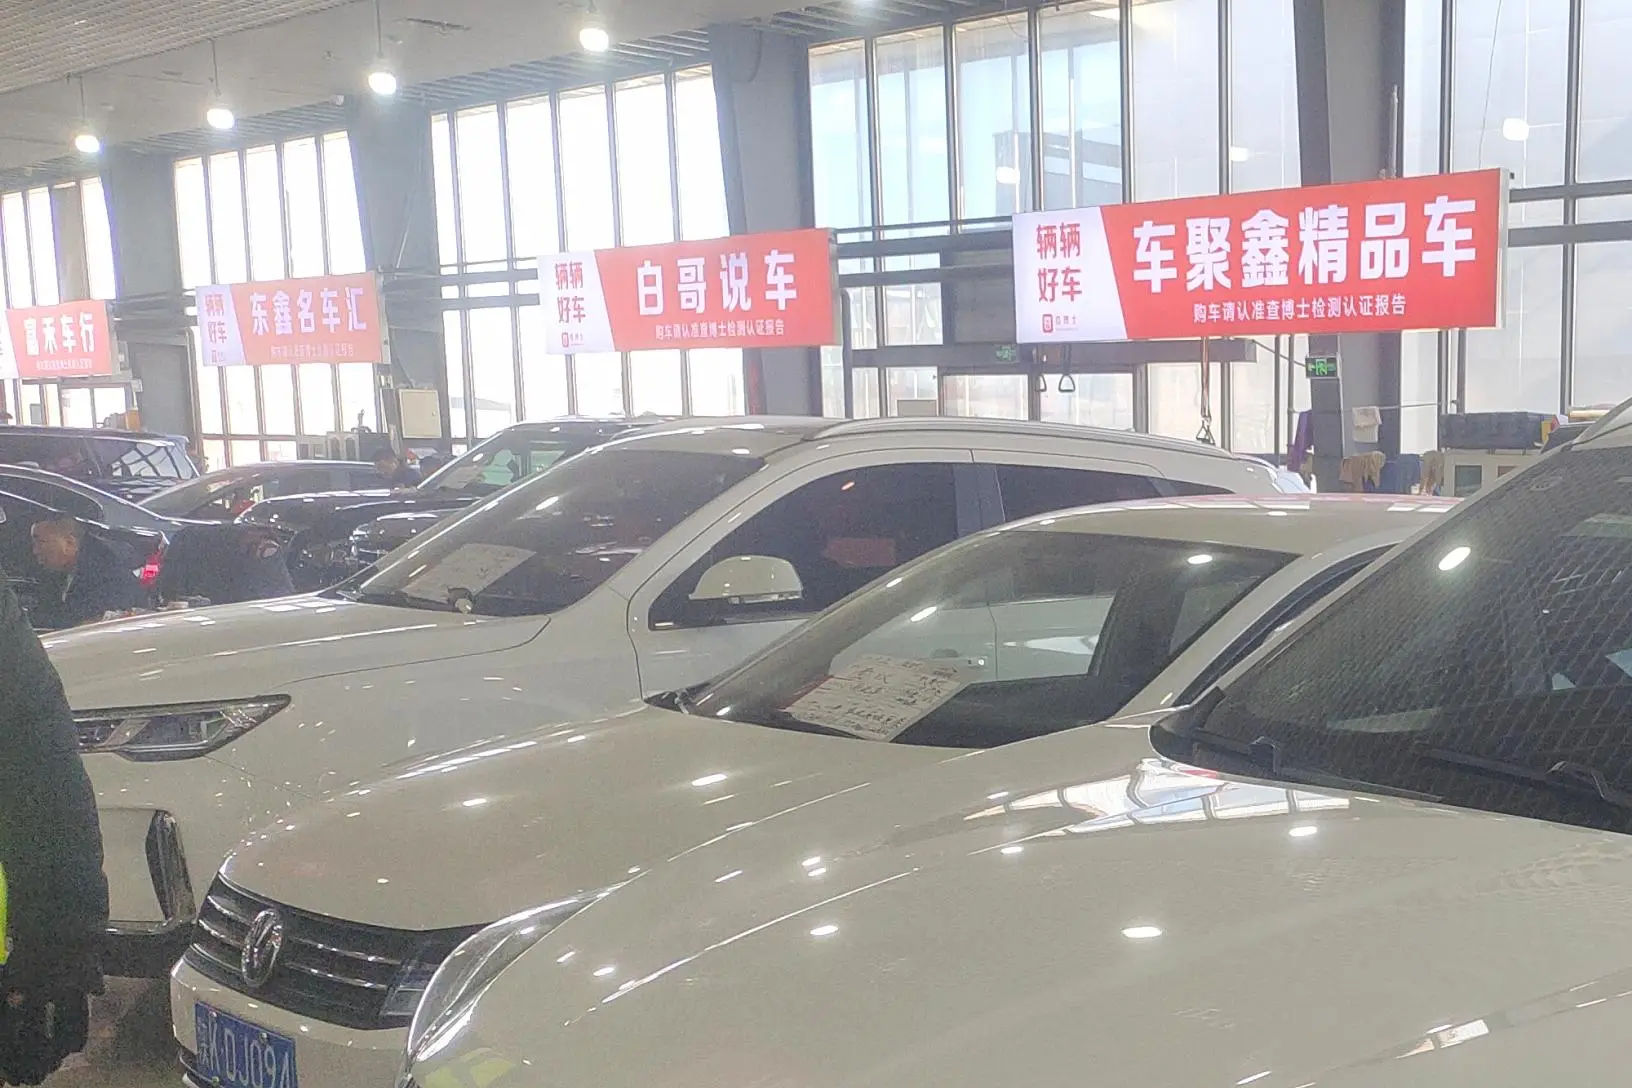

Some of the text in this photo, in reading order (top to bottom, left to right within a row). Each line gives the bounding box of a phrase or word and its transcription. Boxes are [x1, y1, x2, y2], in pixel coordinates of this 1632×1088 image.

[1035, 222, 1081, 260] 辆辆
[1132, 194, 1478, 294] 车聚鑫精品车
[637, 249, 798, 317] 白哥说车
[1037, 266, 1083, 304] 好车
[557, 295, 586, 325] 好车
[1193, 293, 1407, 325] 购车请认准查博士检测认证报告
